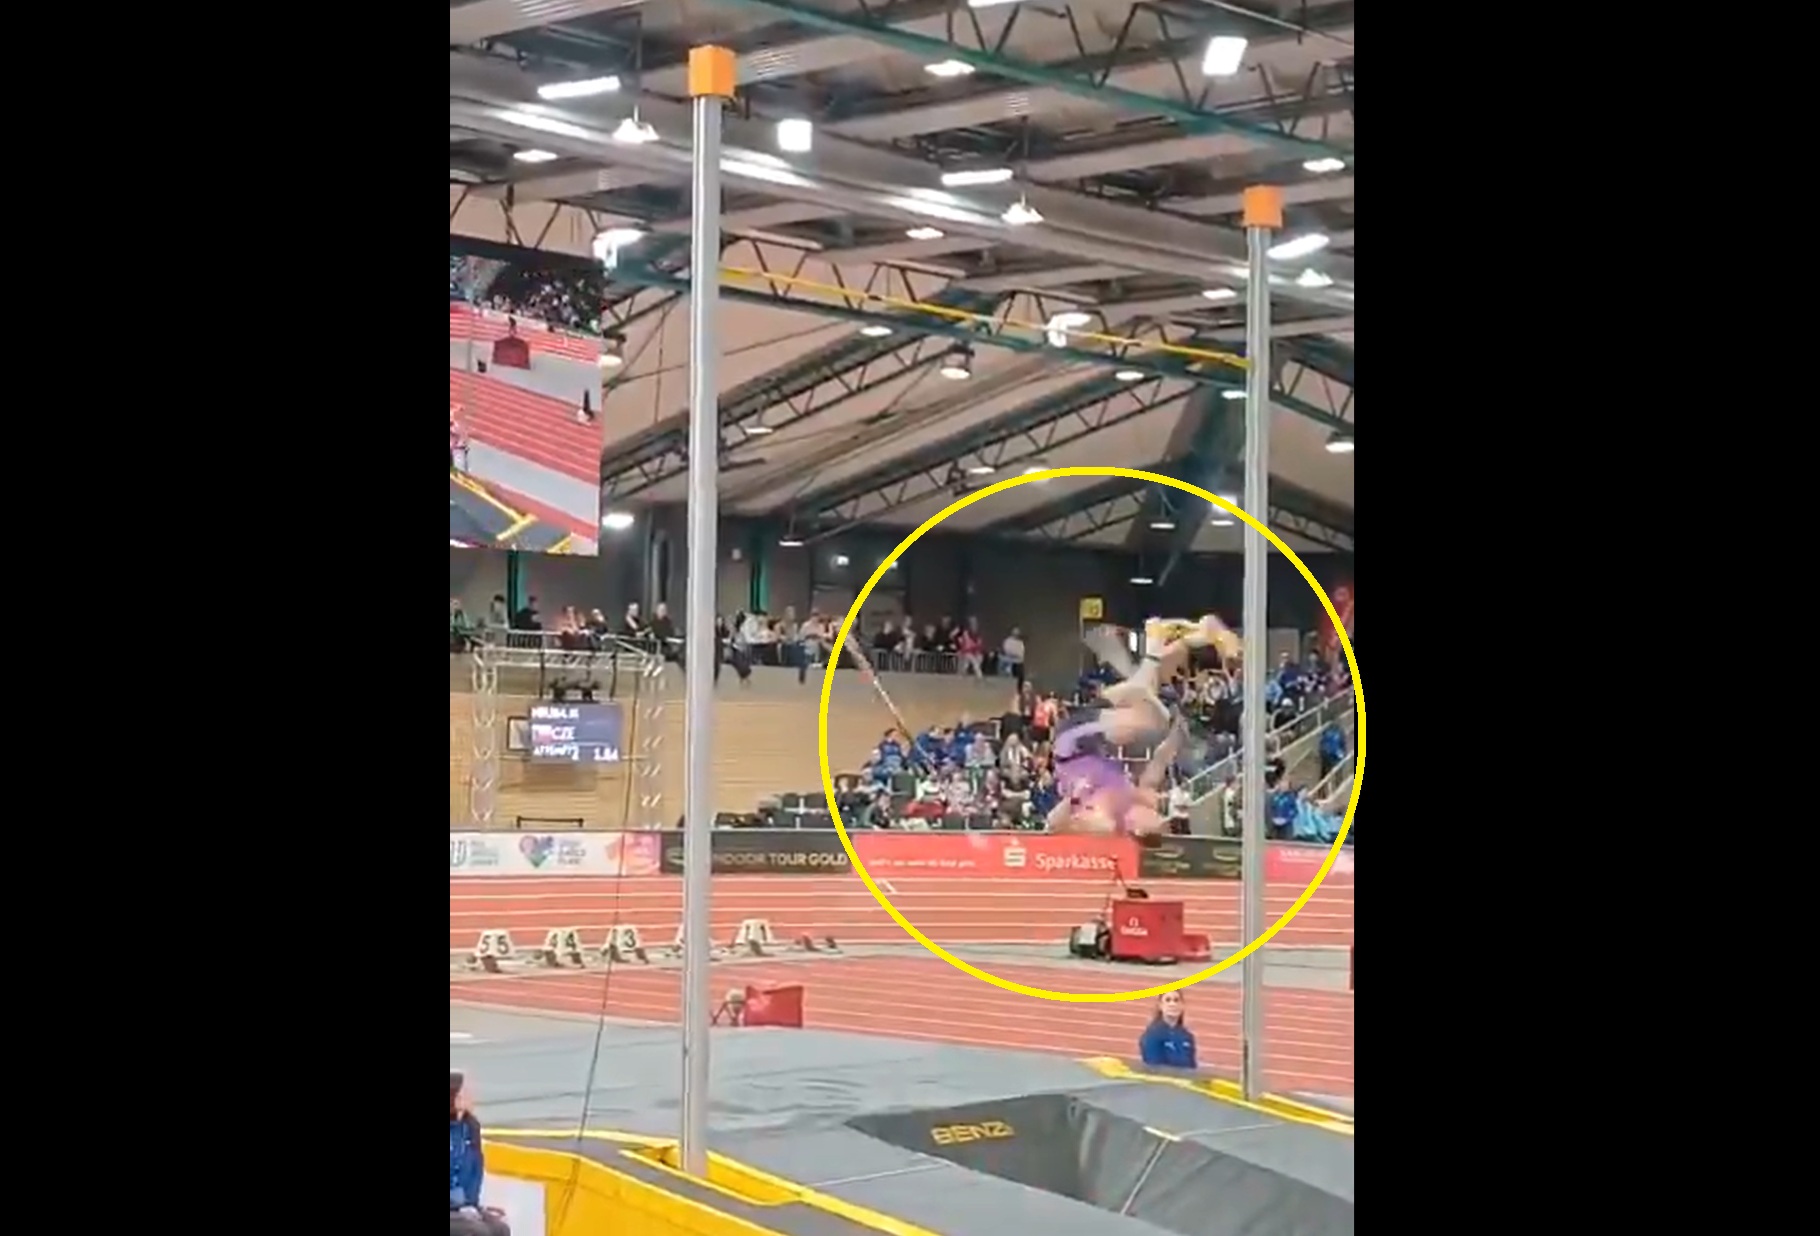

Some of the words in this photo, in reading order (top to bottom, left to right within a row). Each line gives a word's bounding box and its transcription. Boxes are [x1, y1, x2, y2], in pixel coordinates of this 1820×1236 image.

[768, 852, 806, 866] TOUR
[808, 853, 848, 866] GOLD
[1035, 852, 1116, 872] Sparkasse
